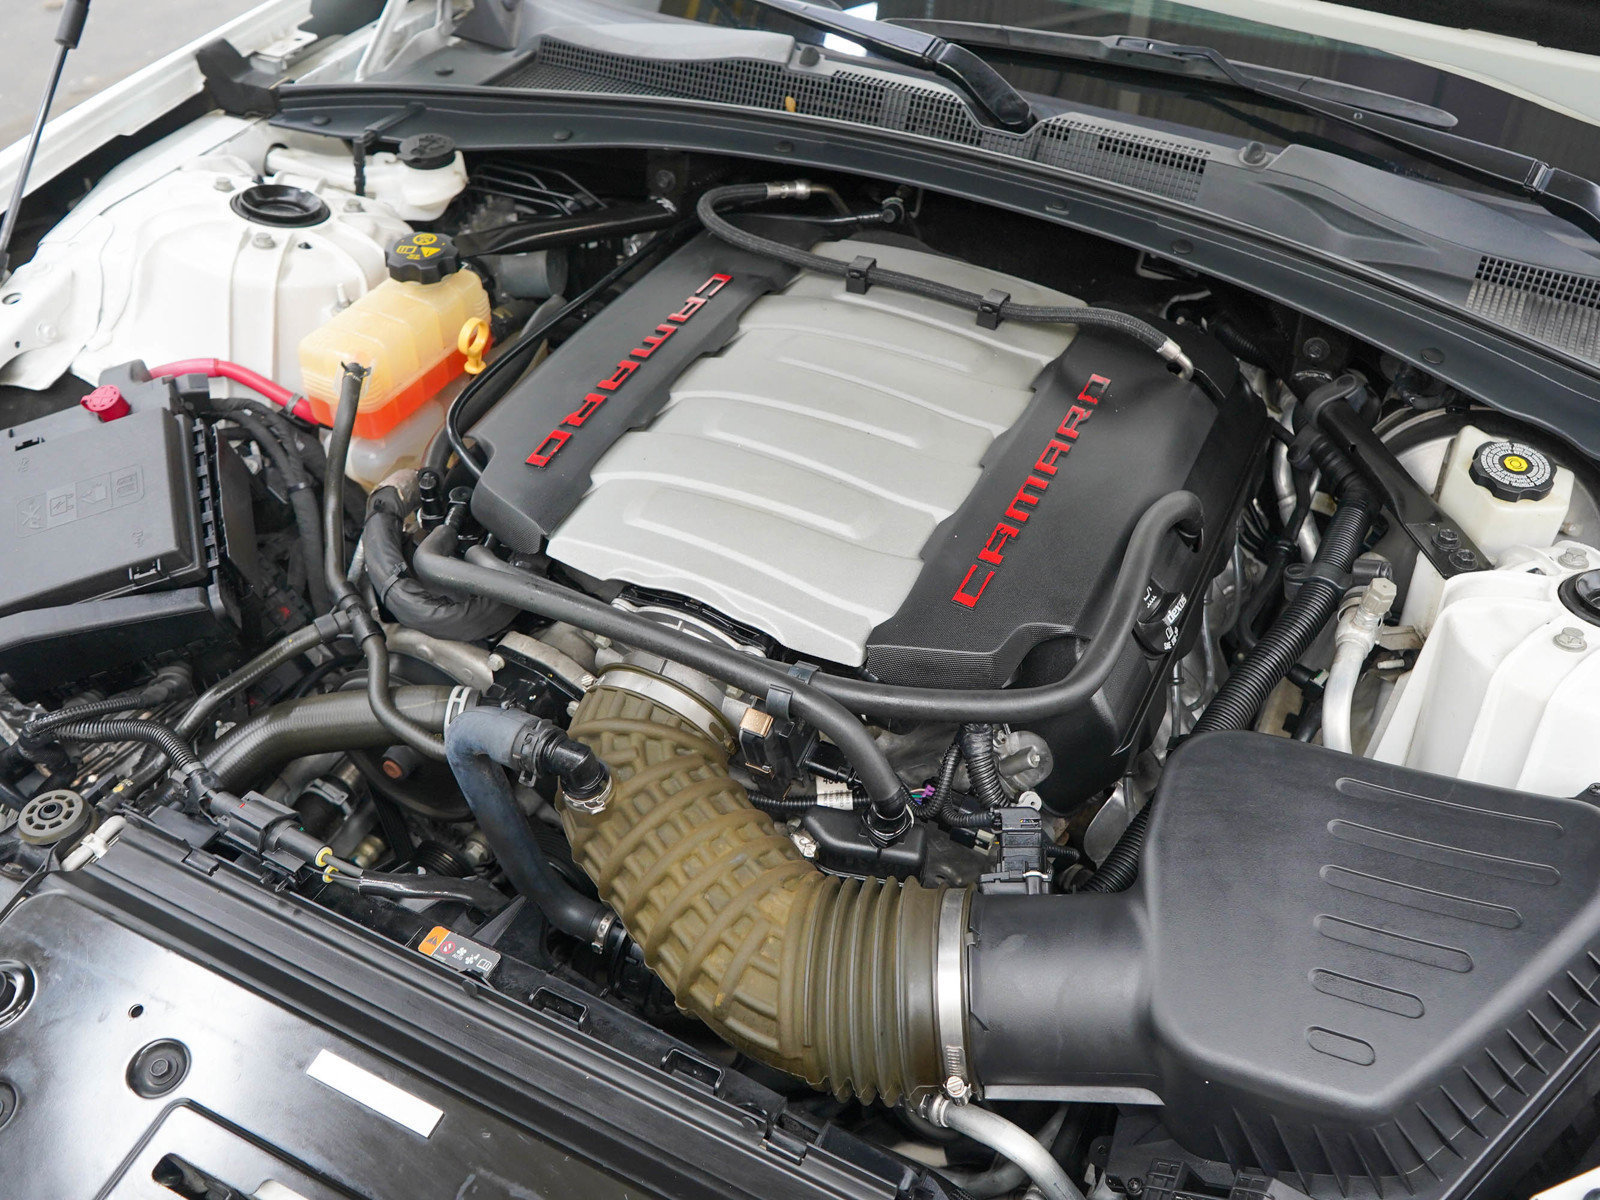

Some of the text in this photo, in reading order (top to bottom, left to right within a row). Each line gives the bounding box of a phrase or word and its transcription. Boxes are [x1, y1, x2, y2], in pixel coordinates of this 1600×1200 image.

[525, 273, 734, 468] CAMARO
[951, 373, 1112, 609] CAMARO
[1167, 594, 1187, 624] dexos
